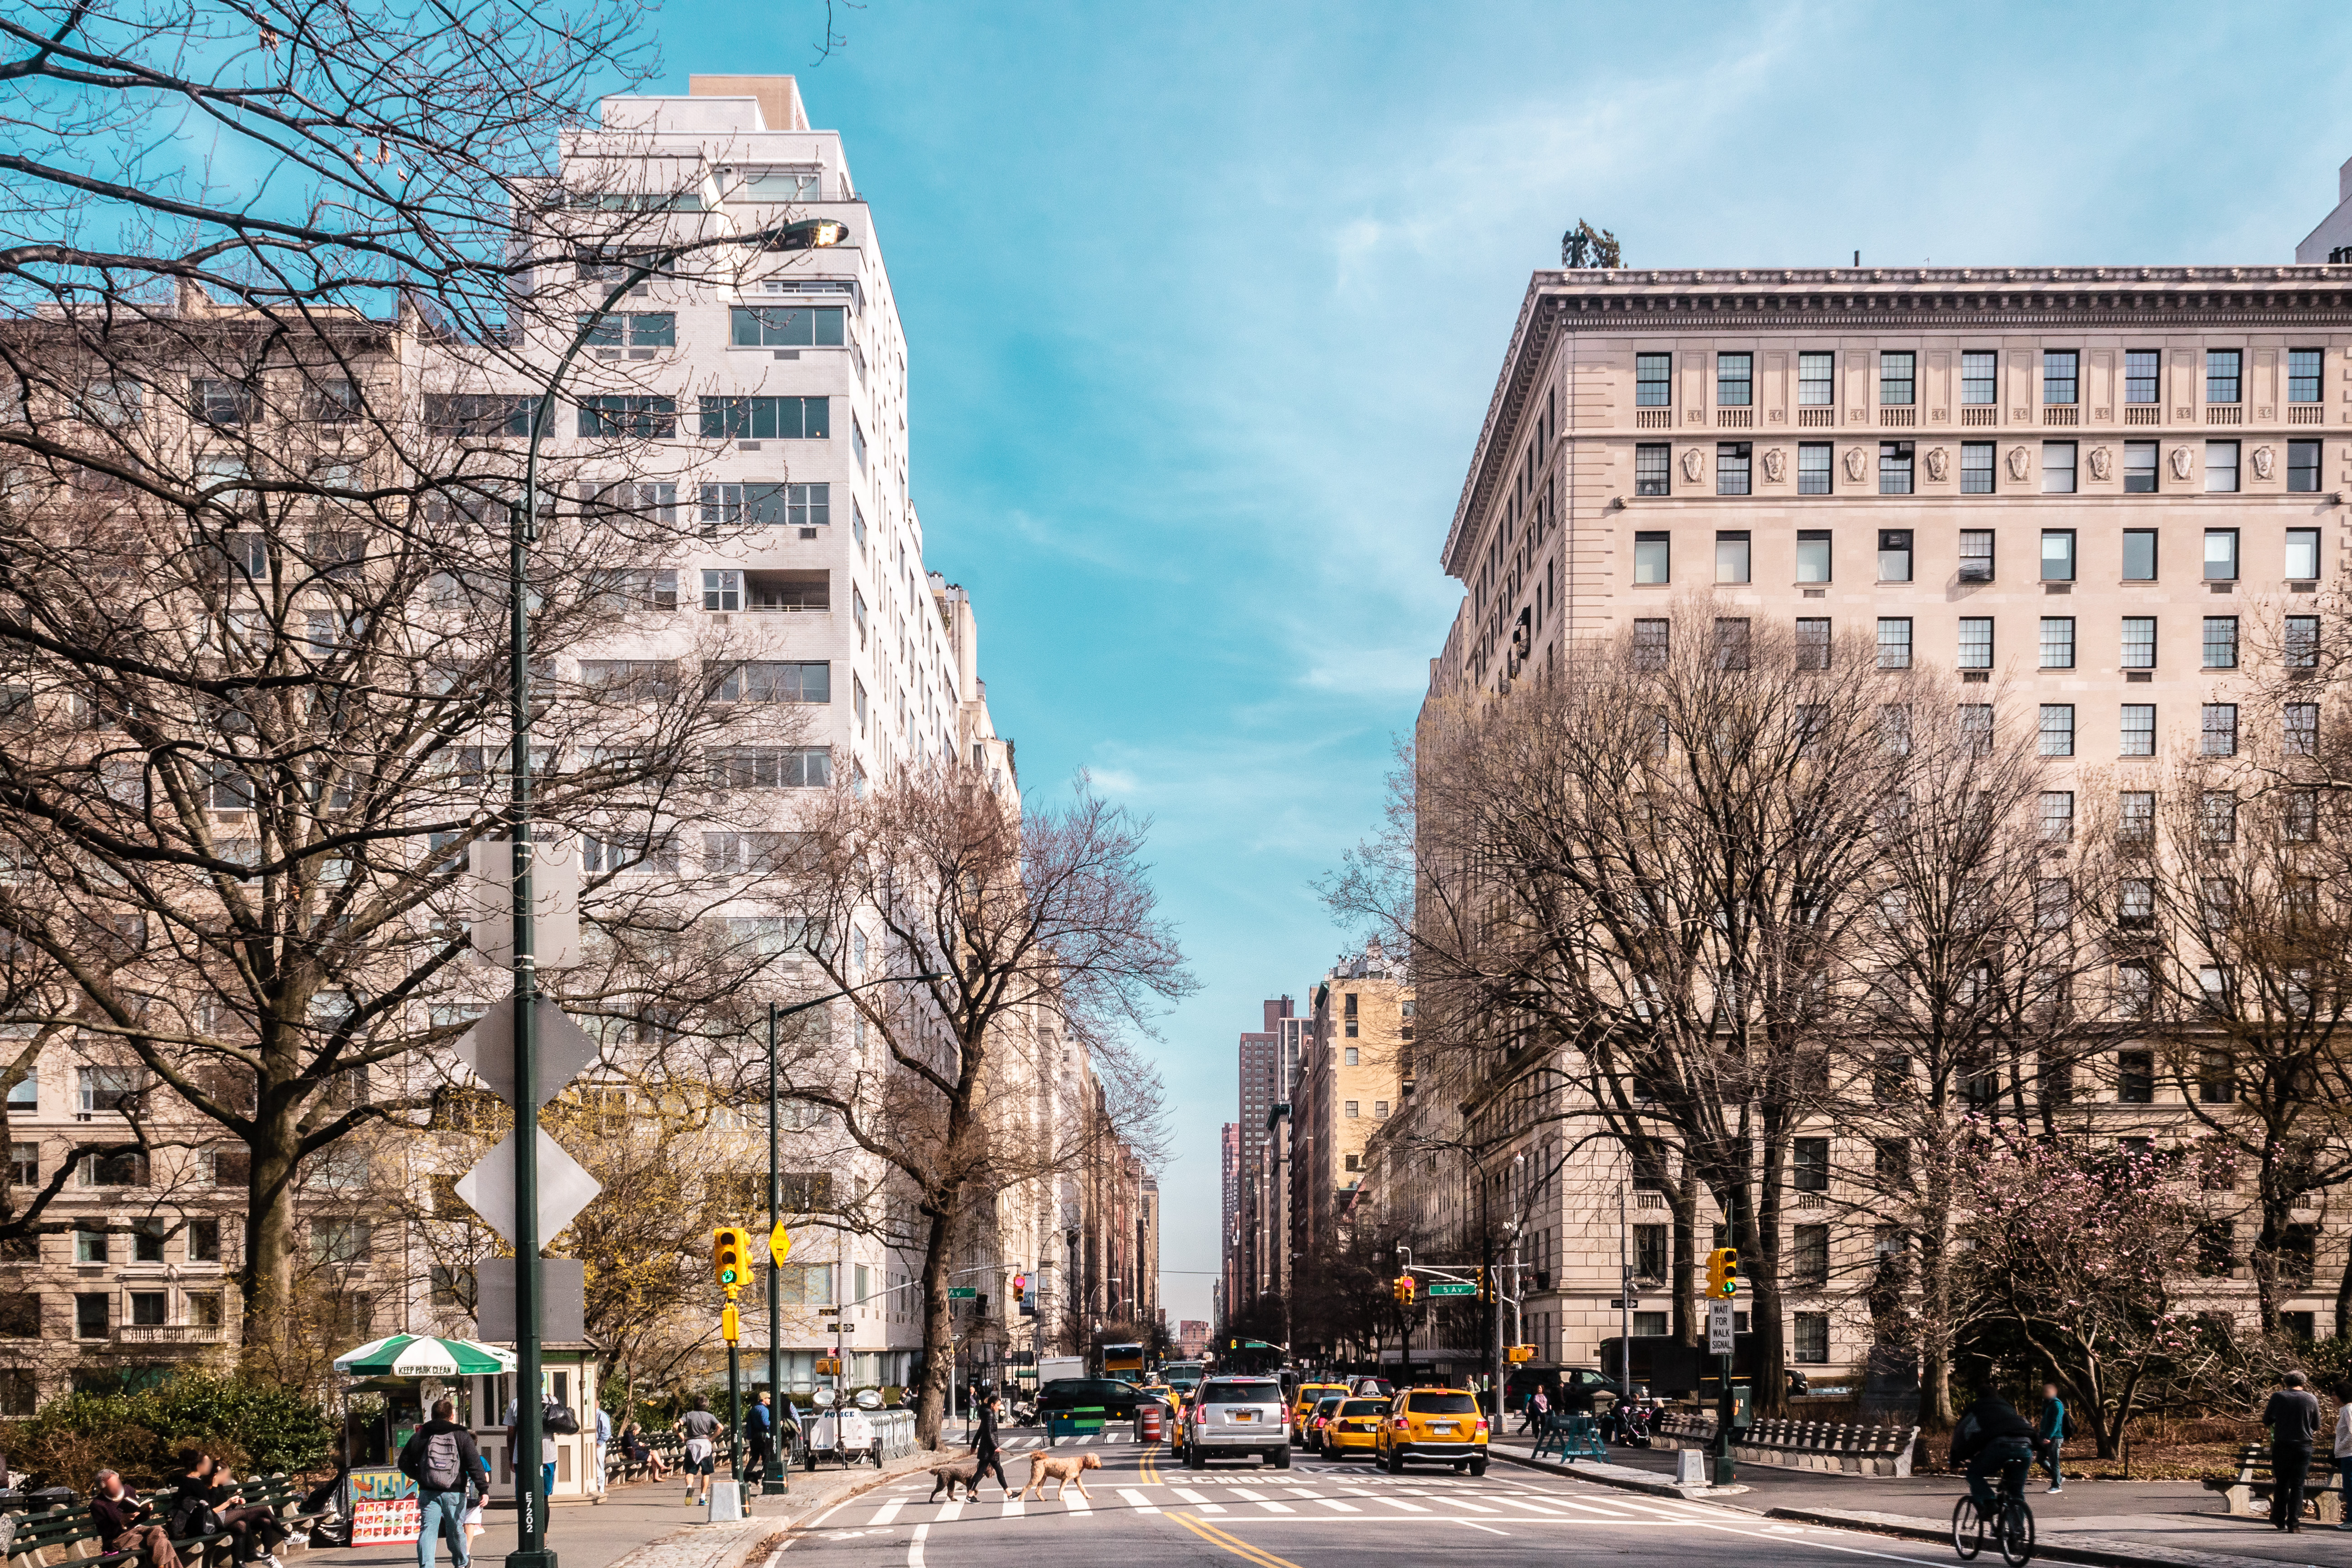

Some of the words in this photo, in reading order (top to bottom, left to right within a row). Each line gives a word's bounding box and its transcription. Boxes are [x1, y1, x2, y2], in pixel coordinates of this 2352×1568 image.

[1714, 1305, 1728, 1313] WAIT
[1715, 1317, 1727, 1325] FOR
[1713, 1329, 1730, 1337] WALK
[1712, 1341, 1732, 1349] SIGNAL
[1165, 1476, 1318, 1484] SCHOOL
[1326, 1476, 1483, 1487] SCHOOL
